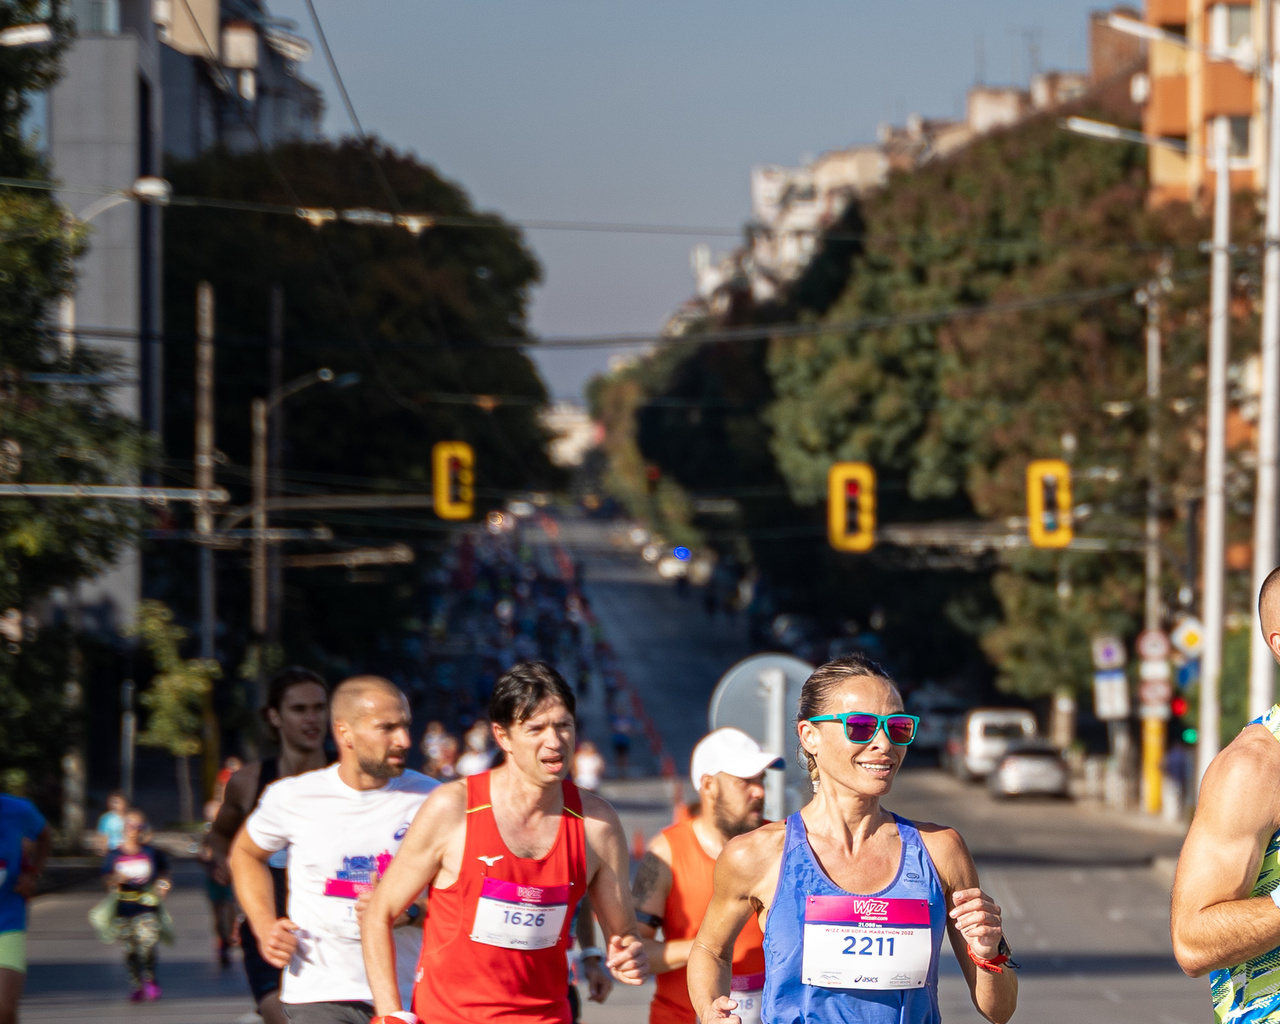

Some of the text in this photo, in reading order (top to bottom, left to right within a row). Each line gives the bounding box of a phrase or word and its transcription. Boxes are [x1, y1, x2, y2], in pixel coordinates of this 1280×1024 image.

[503, 910, 545, 927] 1626
[842, 936, 894, 956] 2211
[739, 998, 754, 1010] 18
